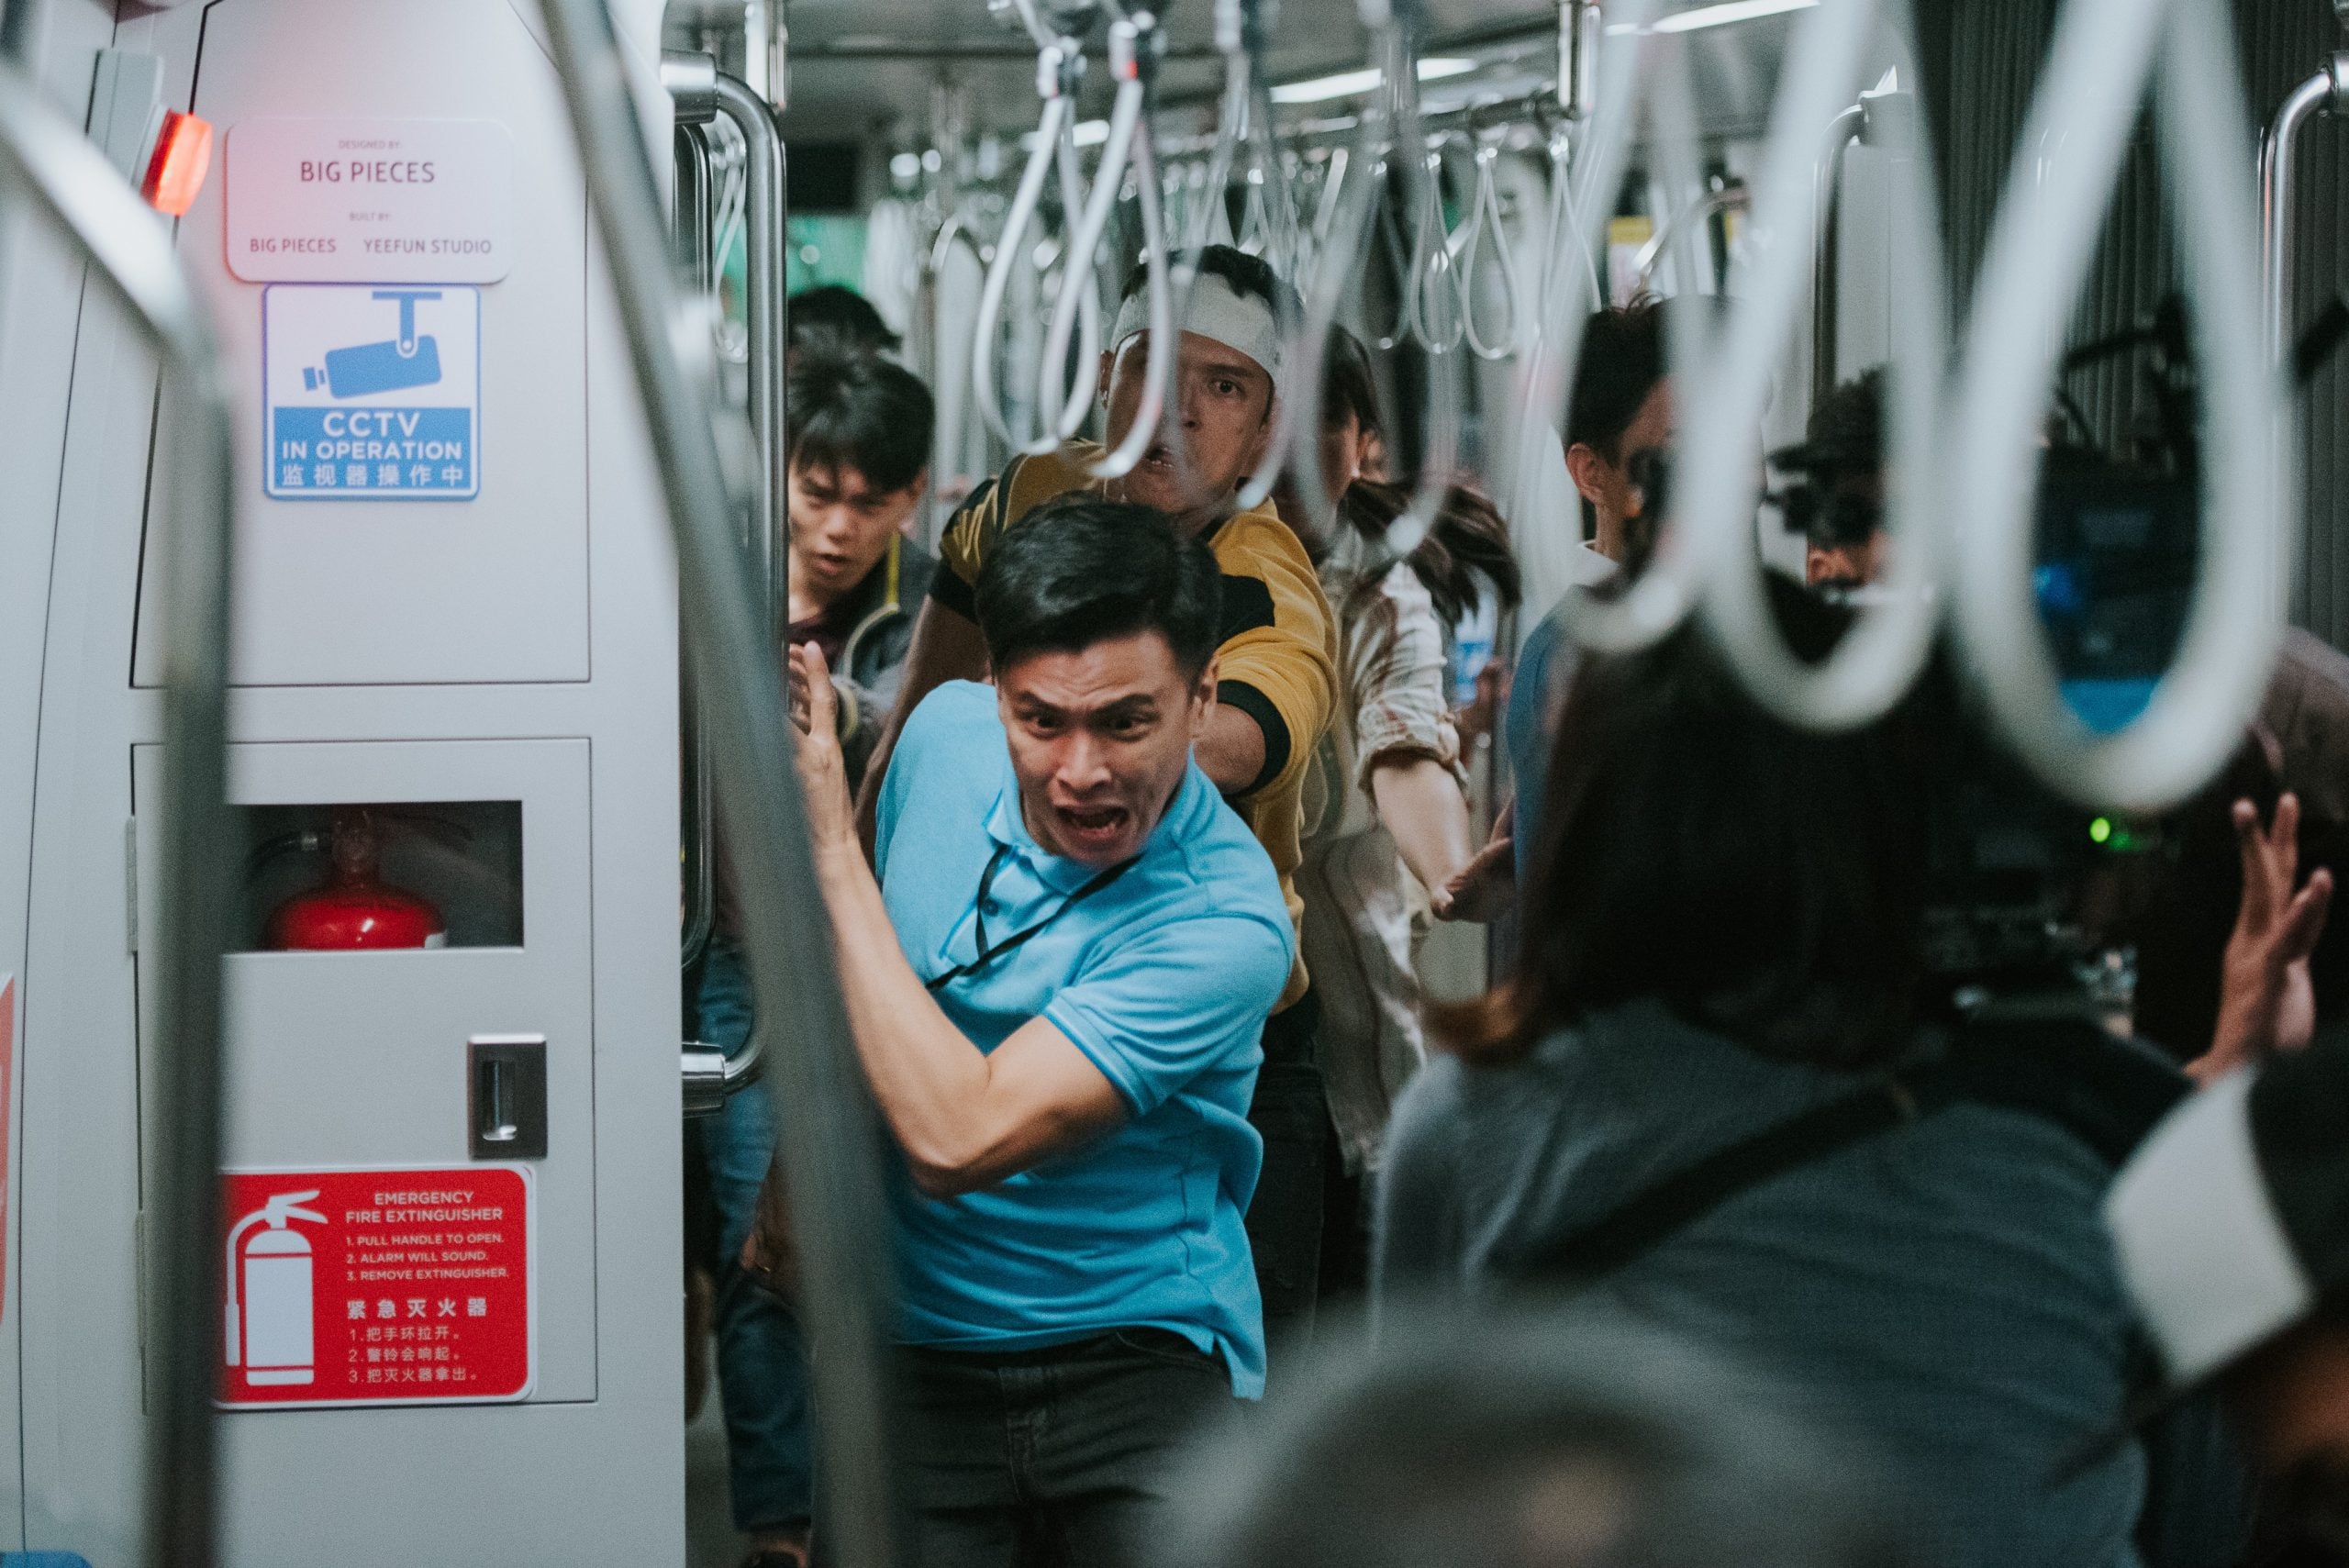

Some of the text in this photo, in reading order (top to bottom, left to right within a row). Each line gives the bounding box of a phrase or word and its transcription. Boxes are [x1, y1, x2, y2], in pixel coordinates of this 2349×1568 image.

[338, 139, 386, 150] DESIGNED
[300, 161, 436, 183] BIG PIECES
[350, 212, 375, 222] BUILT
[250, 239, 337, 253] BIG PIECES
[363, 239, 492, 254] YEEFUN STUDIO
[323, 411, 421, 438] CCTV
[282, 440, 462, 461] IN OPERATION
[282, 463, 463, 487] 监视器操作中
[374, 1192, 474, 1206] EMERGENCY
[345, 1208, 503, 1223] FIRE EXTINGUISHER
[346, 1233, 505, 1246] 1. PULL HANDLE TO OPEN.
[346, 1251, 488, 1264] 2. ALARM WILL SOUND.
[361, 1269, 414, 1281] REMOVE
[417, 1268, 509, 1280] EXTINGUISHER.
